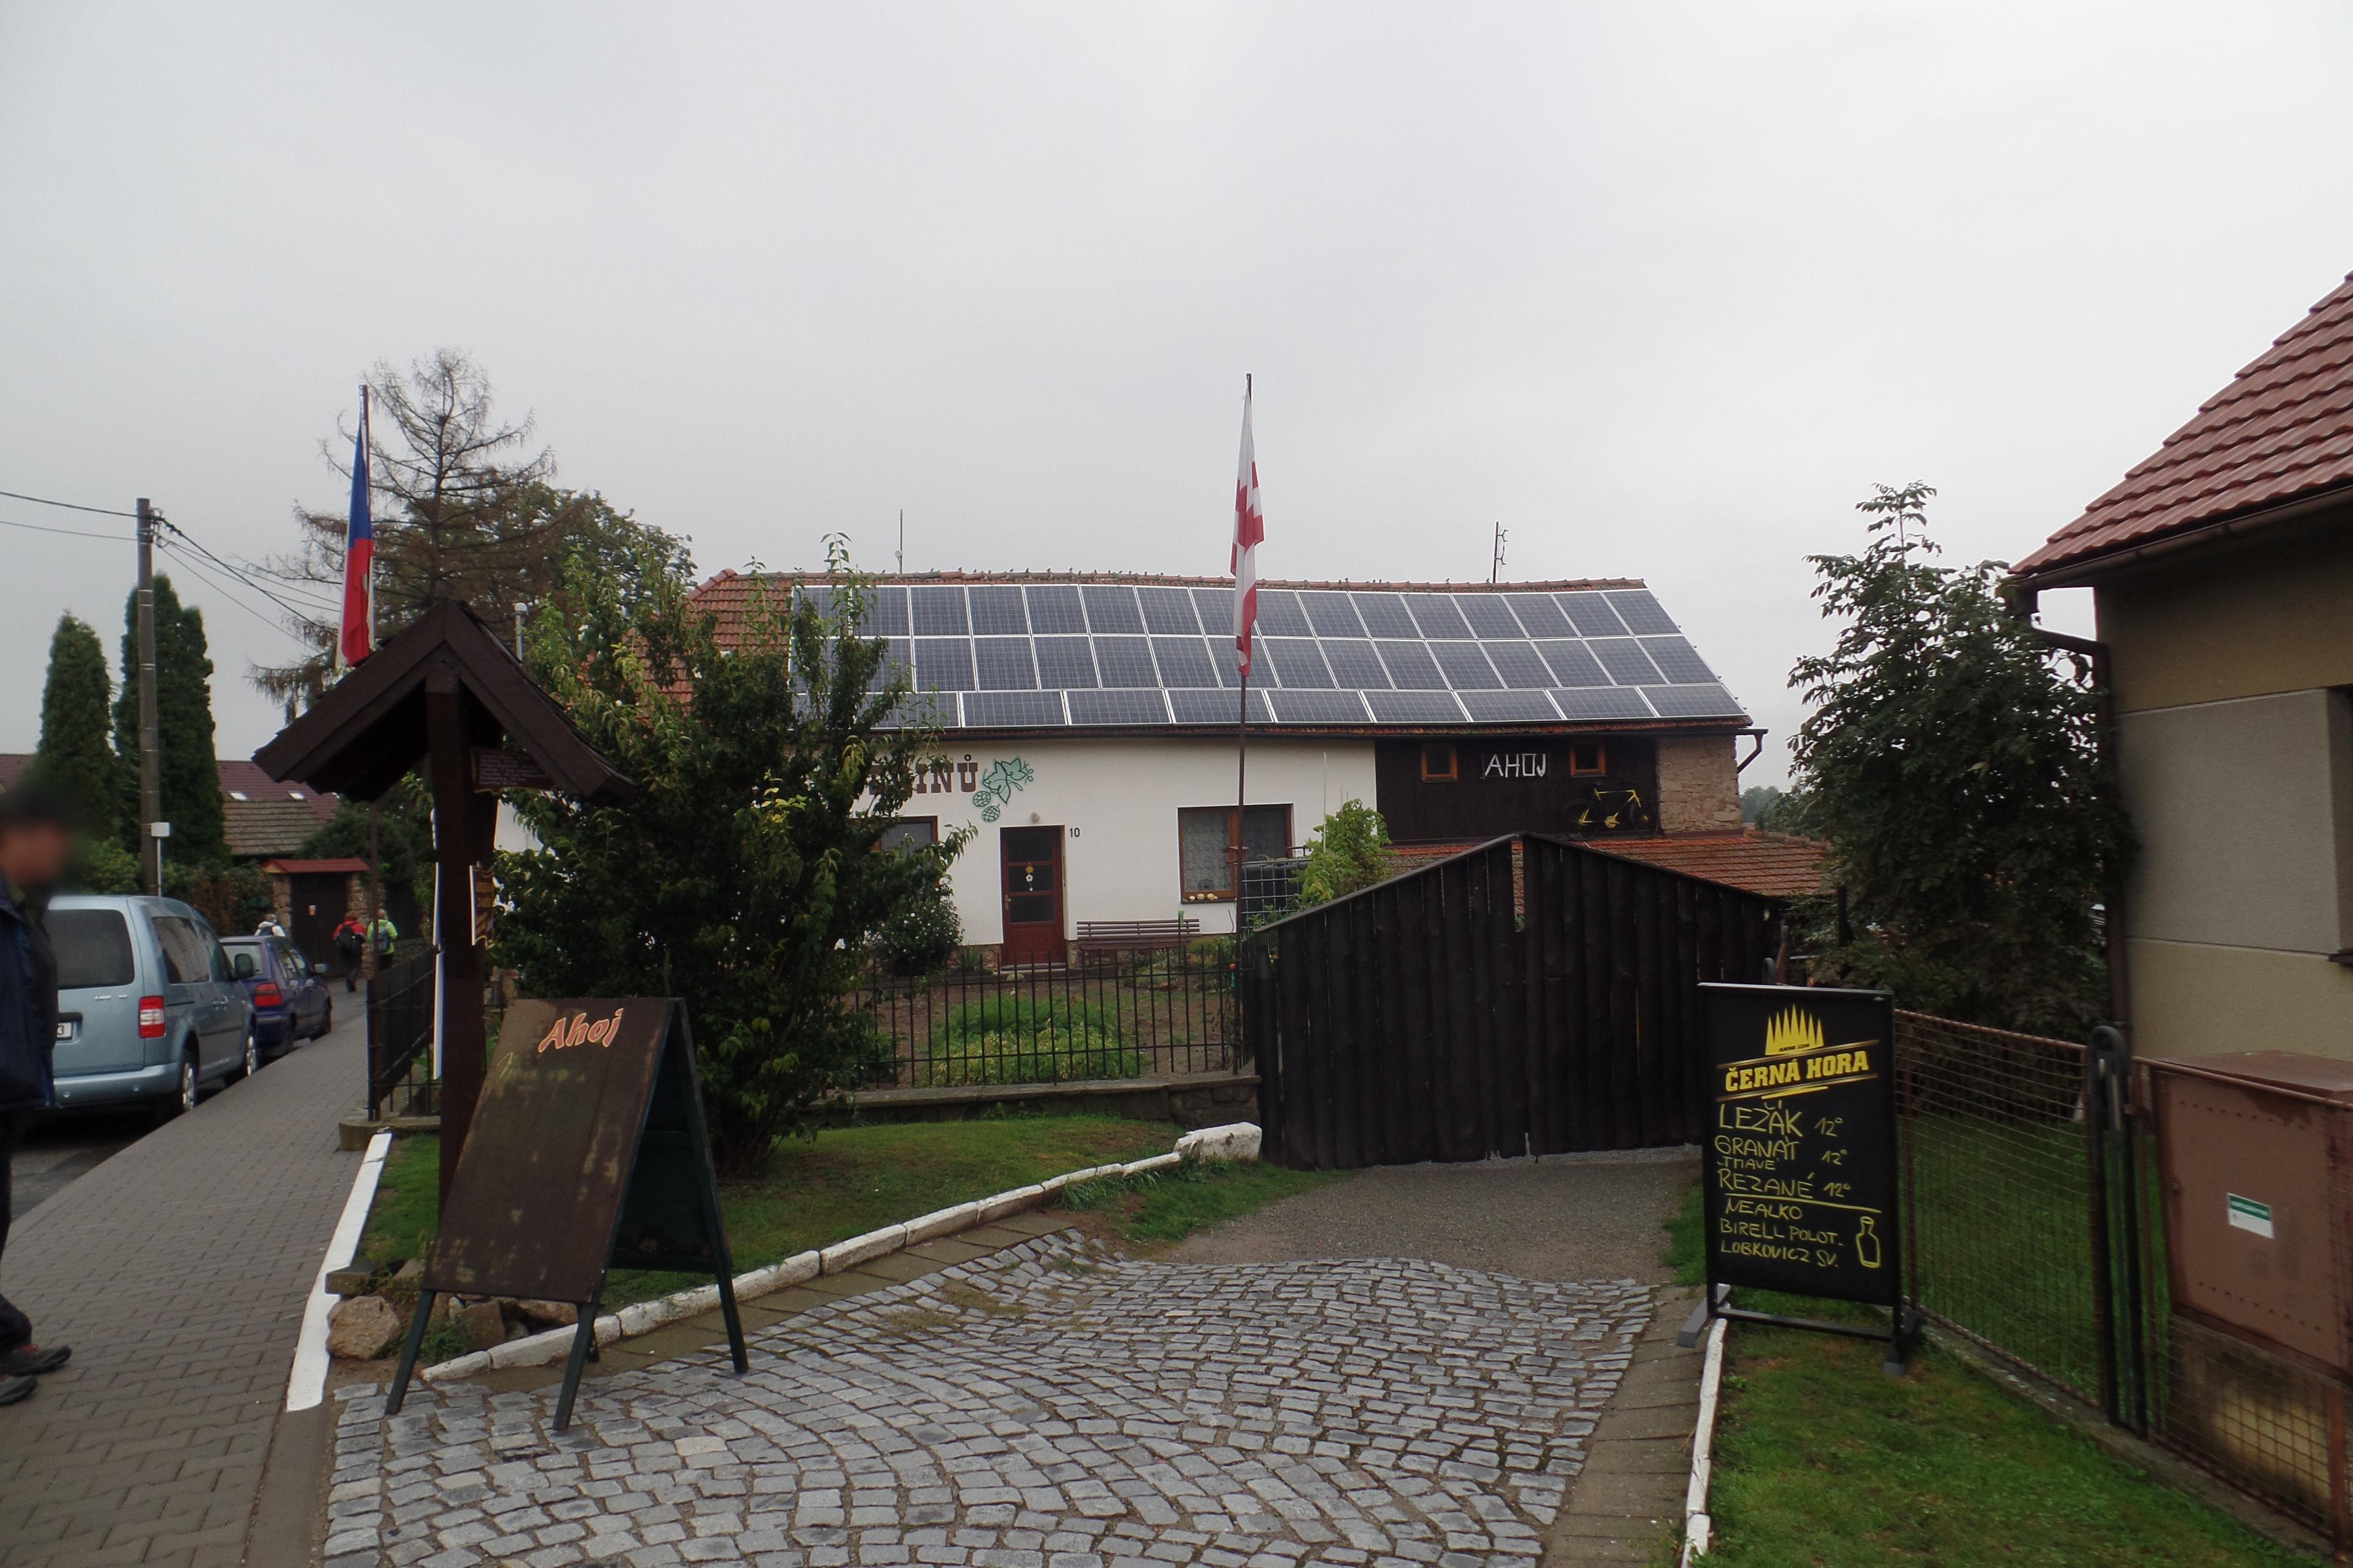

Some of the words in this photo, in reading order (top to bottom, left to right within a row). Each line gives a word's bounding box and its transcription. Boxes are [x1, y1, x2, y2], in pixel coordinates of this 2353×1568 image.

[1484, 753, 1546, 778] AHOJ
[1069, 827, 1081, 838] 10
[538, 1007, 624, 1053] Ahoj
[1725, 1059, 1801, 1092] ČERNÁ
[1807, 1050, 1868, 1079] HORA
[1719, 1100, 1803, 1137] LEŽÁK
[1725, 1198, 1802, 1220] NEALKO
[1720, 1218, 1785, 1239] BIRELL
[1789, 1225, 1844, 1246] POLOT.
[1720, 1239, 1810, 1263] LOBKOVICZ
[1816, 1249, 1838, 1267] SV.
